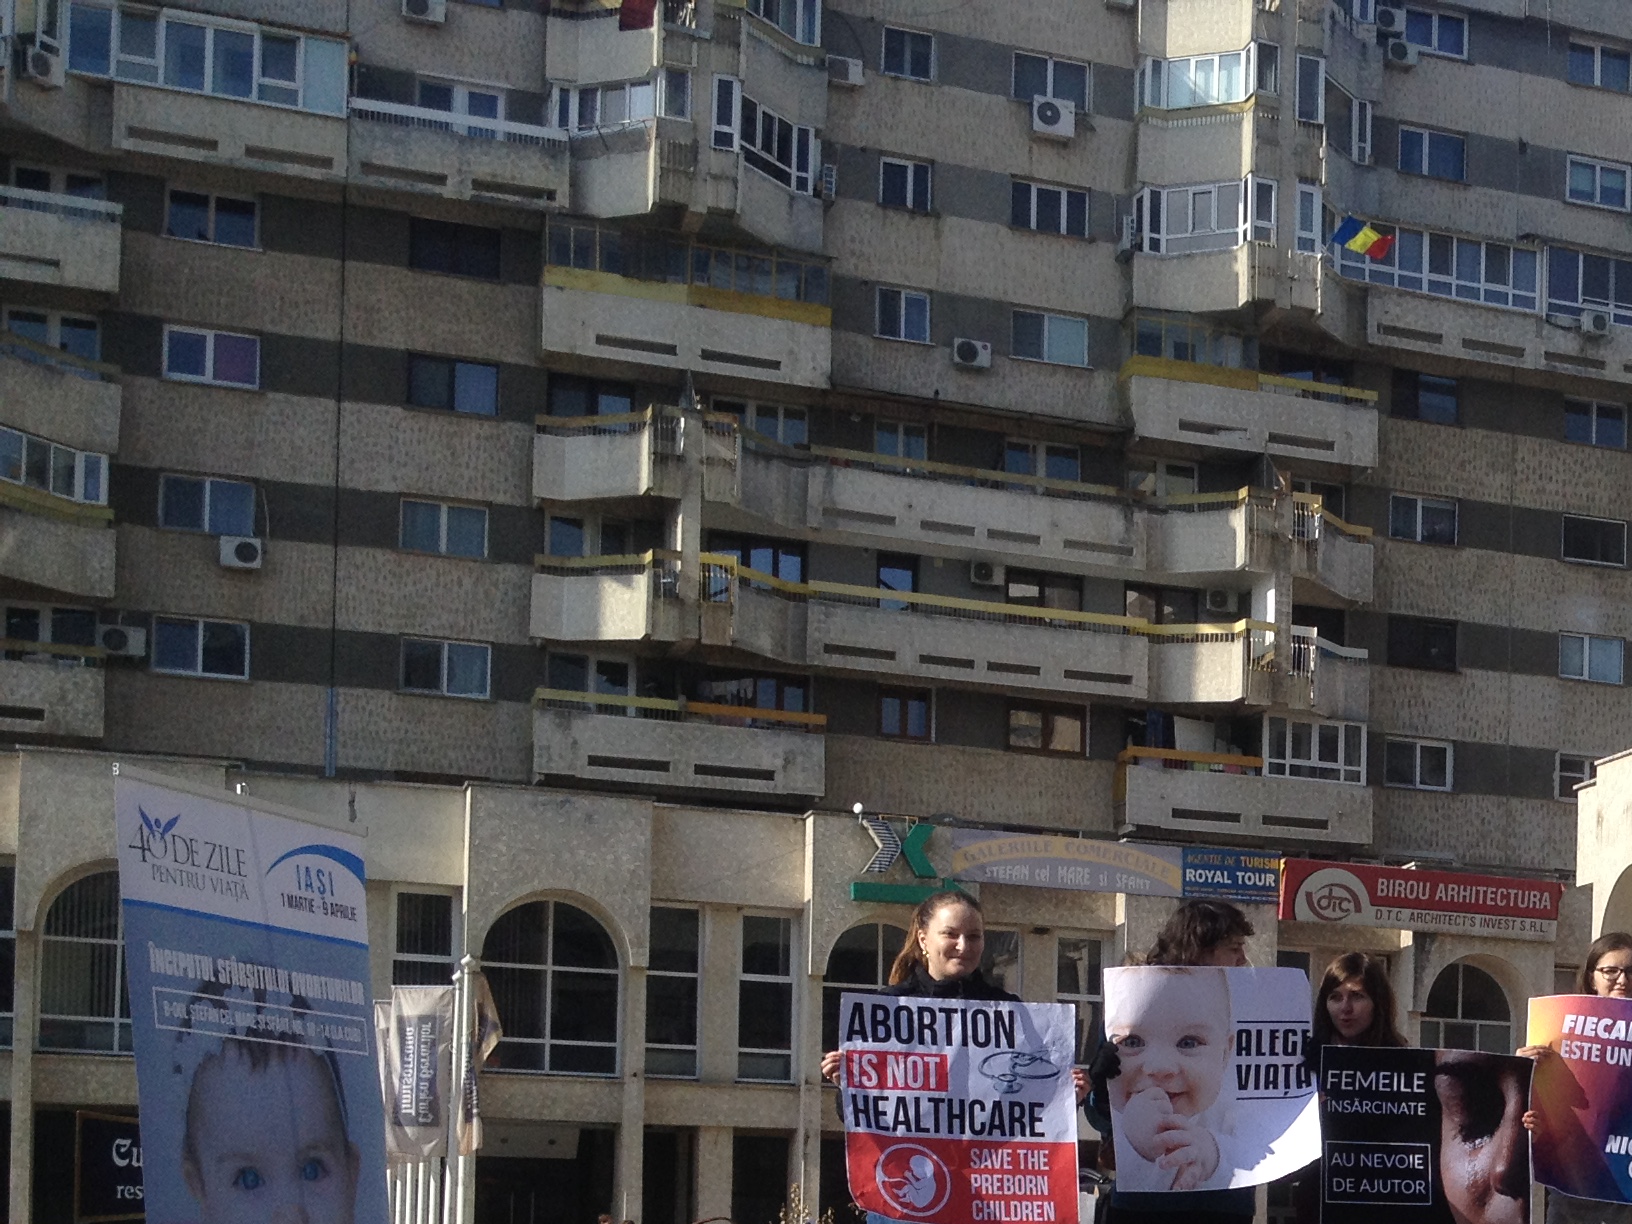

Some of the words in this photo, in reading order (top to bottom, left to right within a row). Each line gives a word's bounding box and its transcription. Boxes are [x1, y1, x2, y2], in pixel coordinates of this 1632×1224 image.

[129, 824, 168, 862] 40
[172, 833, 200, 868] DE
[204, 842, 247, 878] ZILE
[1064, 841, 1171, 878] COMERCIALE
[1240, 856, 1279, 870] TURISM
[152, 864, 206, 891] PENTRU
[985, 864, 1030, 881] STEFAN
[1035, 864, 1050, 882] cel
[1058, 866, 1091, 886] MARE
[1116, 874, 1150, 890] SFANT
[1185, 868, 1232, 884] ROYAL
[1236, 872, 1276, 887] TOUR
[1377, 878, 1430, 900] BIROU
[1435, 883, 1551, 909] ARHITECTURA
[286, 893, 316, 914] MARTIE
[330, 902, 357, 922] APRILIE
[1374, 909, 1405, 922] D.T.C.
[1408, 912, 1476, 928] ARCHITECT'S
[1480, 916, 1516, 930] INVEST
[1518, 920, 1549, 933] S.R.L.
[846, 1002, 1016, 1049] ABORTION
[1560, 1040, 1602, 1062] ESTE
[1606, 1046, 1631, 1066] UN
[852, 1053, 879, 1088] IS
[886, 1055, 940, 1090] NOT
[1326, 1070, 1426, 1093] FEMEILE
[851, 1094, 1046, 1138] HEALTHCARE
[1326, 1097, 1426, 1116] ÎNSĂRCINATE
[970, 1148, 1014, 1170] SAVE
[1018, 1150, 1049, 1171] THE
[1331, 1152, 1354, 1167] AU
[1360, 1153, 1424, 1170] NEVOIE
[970, 1174, 1049, 1196] PREBORN
[1332, 1178, 1355, 1192] DE
[1360, 1179, 1426, 1195] AJUTOR
[972, 1200, 1056, 1222] CHILDREN
